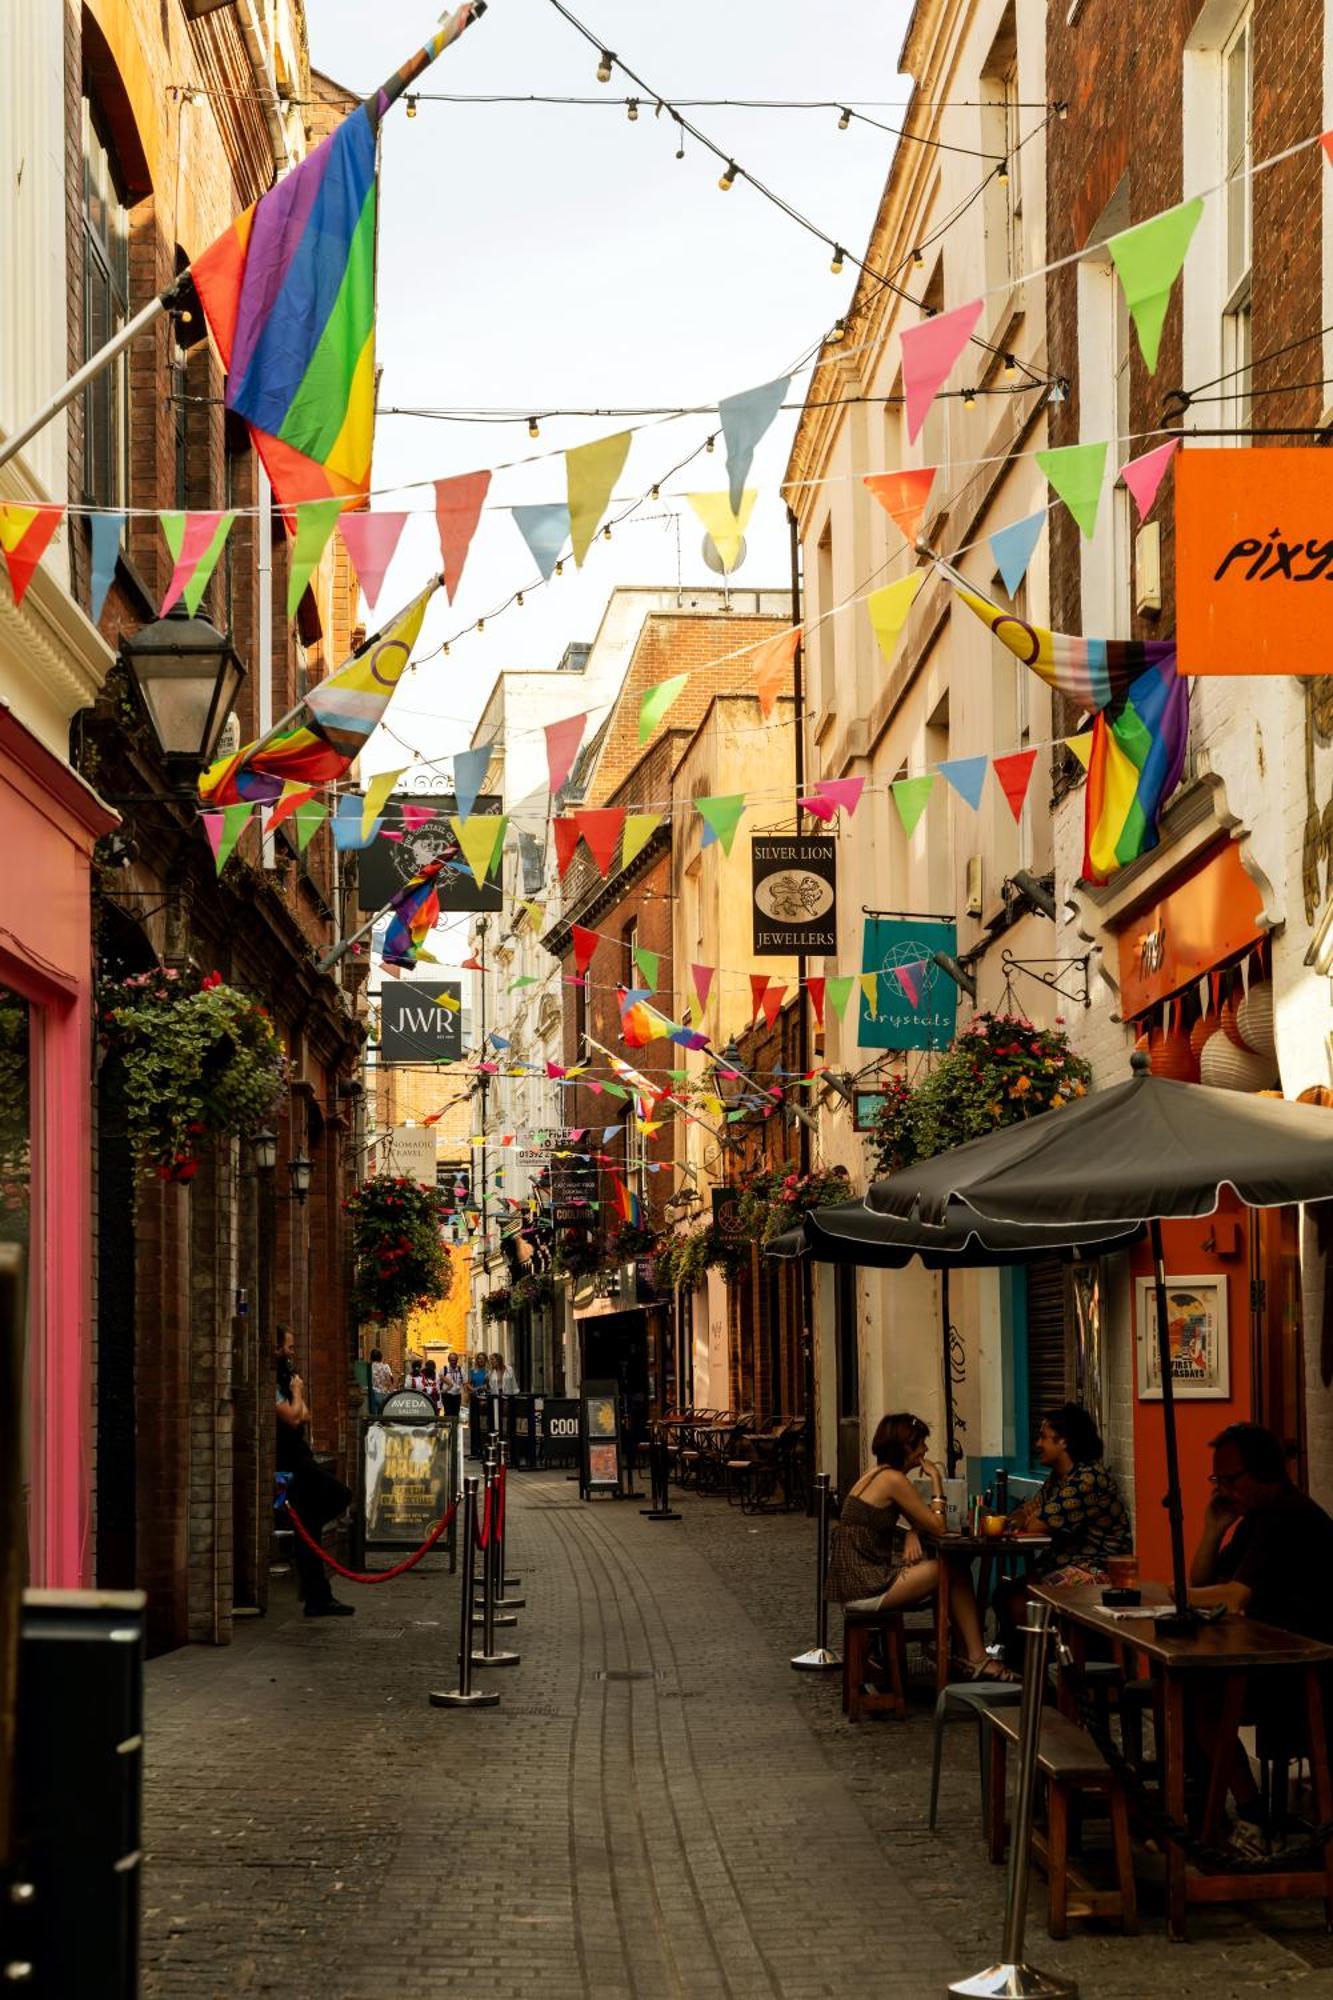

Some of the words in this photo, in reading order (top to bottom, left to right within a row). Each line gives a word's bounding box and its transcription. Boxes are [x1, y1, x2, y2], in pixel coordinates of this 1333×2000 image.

[413, 823, 446, 836] OCKTAIL
[754, 847, 797, 860] SILVER
[800, 847, 833, 860] LION
[757, 932, 835, 949] JEWELLERS
[389, 1007, 454, 1033] JWR
[863, 1010, 951, 1028] Crystals
[392, 1140, 433, 1149] NOMADIC
[1171, 1369, 1205, 1378] RSDAYS
[391, 1399, 427, 1409] AVEDA
